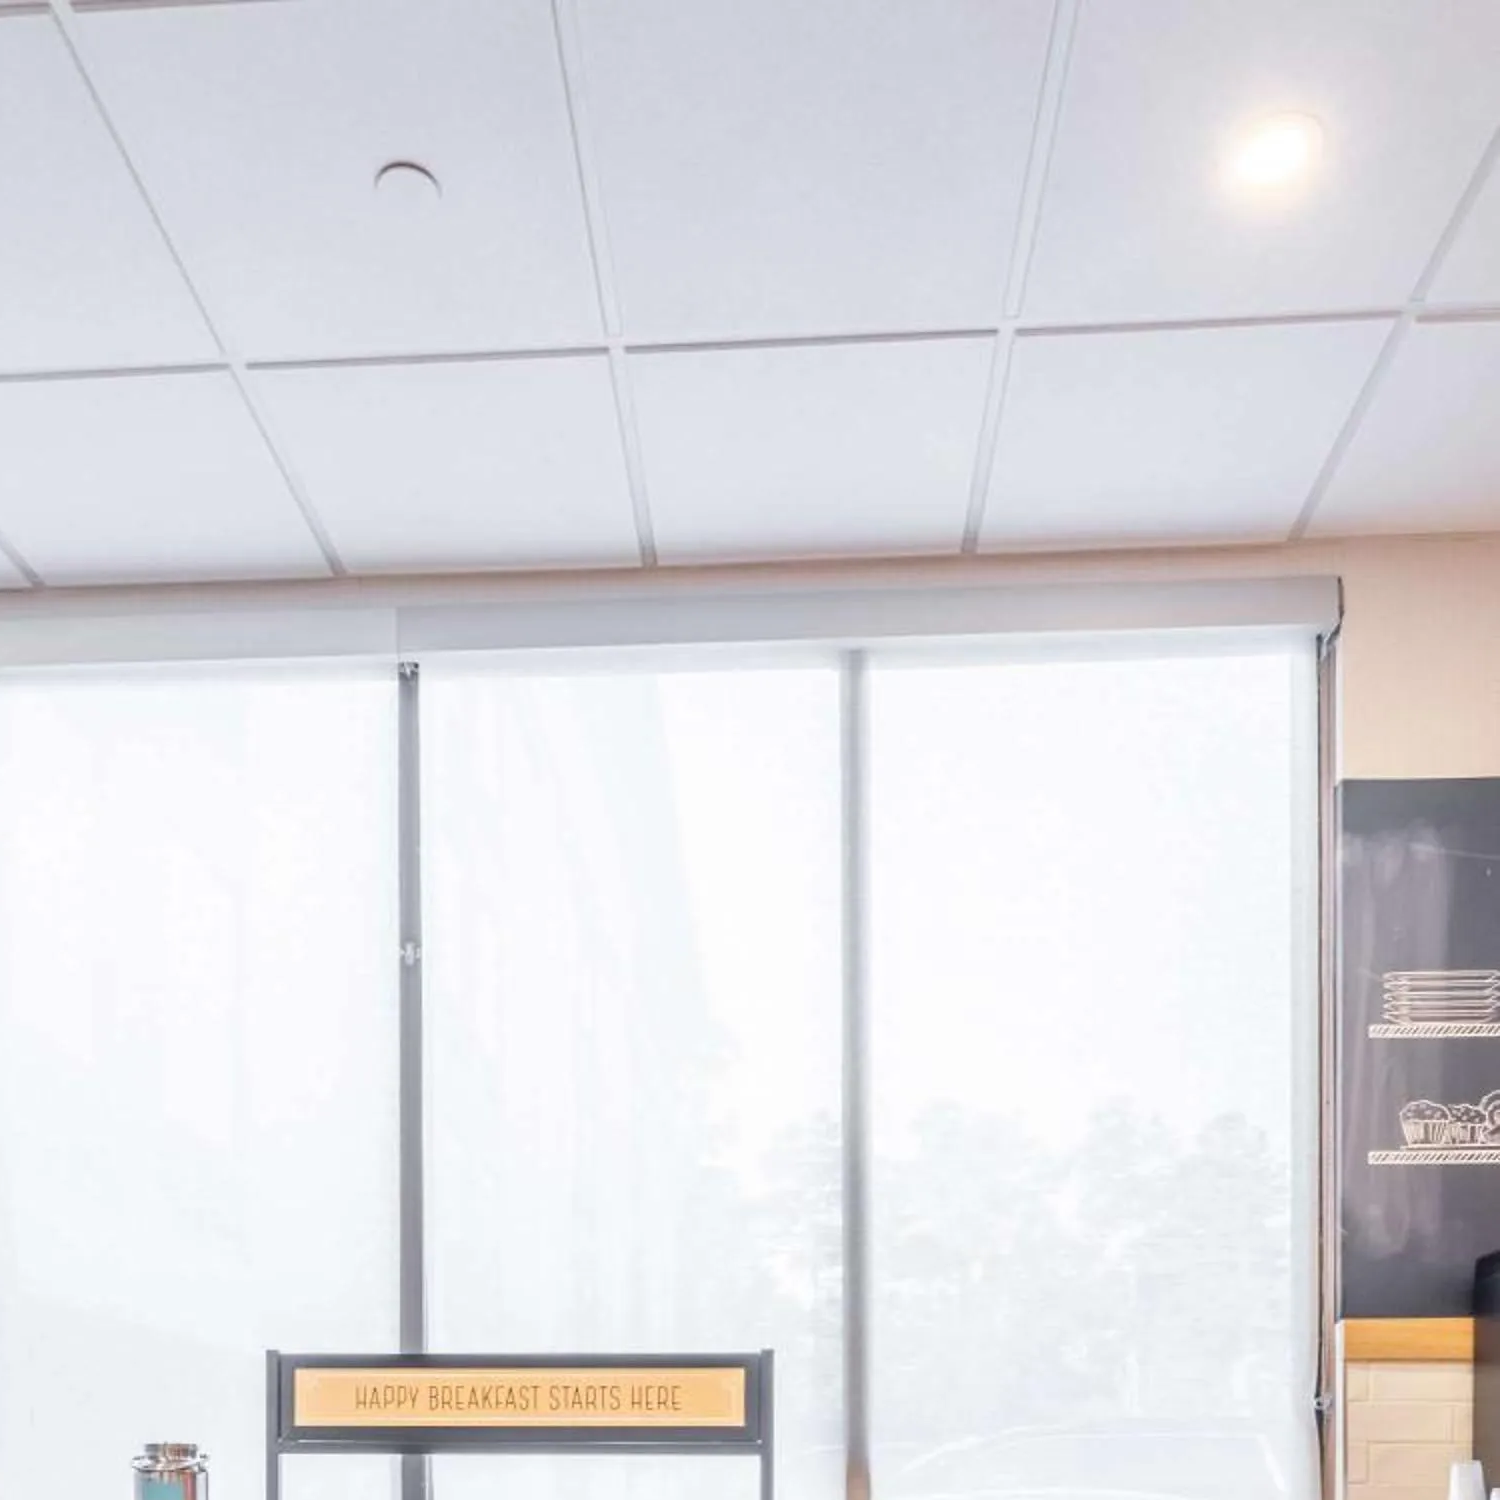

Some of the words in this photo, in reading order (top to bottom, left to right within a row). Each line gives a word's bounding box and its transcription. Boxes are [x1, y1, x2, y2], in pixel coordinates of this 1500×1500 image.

[355, 1385, 419, 1410] HAPPY
[429, 1385, 540, 1411] BREAKFAST
[549, 1385, 621, 1411] STARTS
[630, 1385, 682, 1411] HERE
